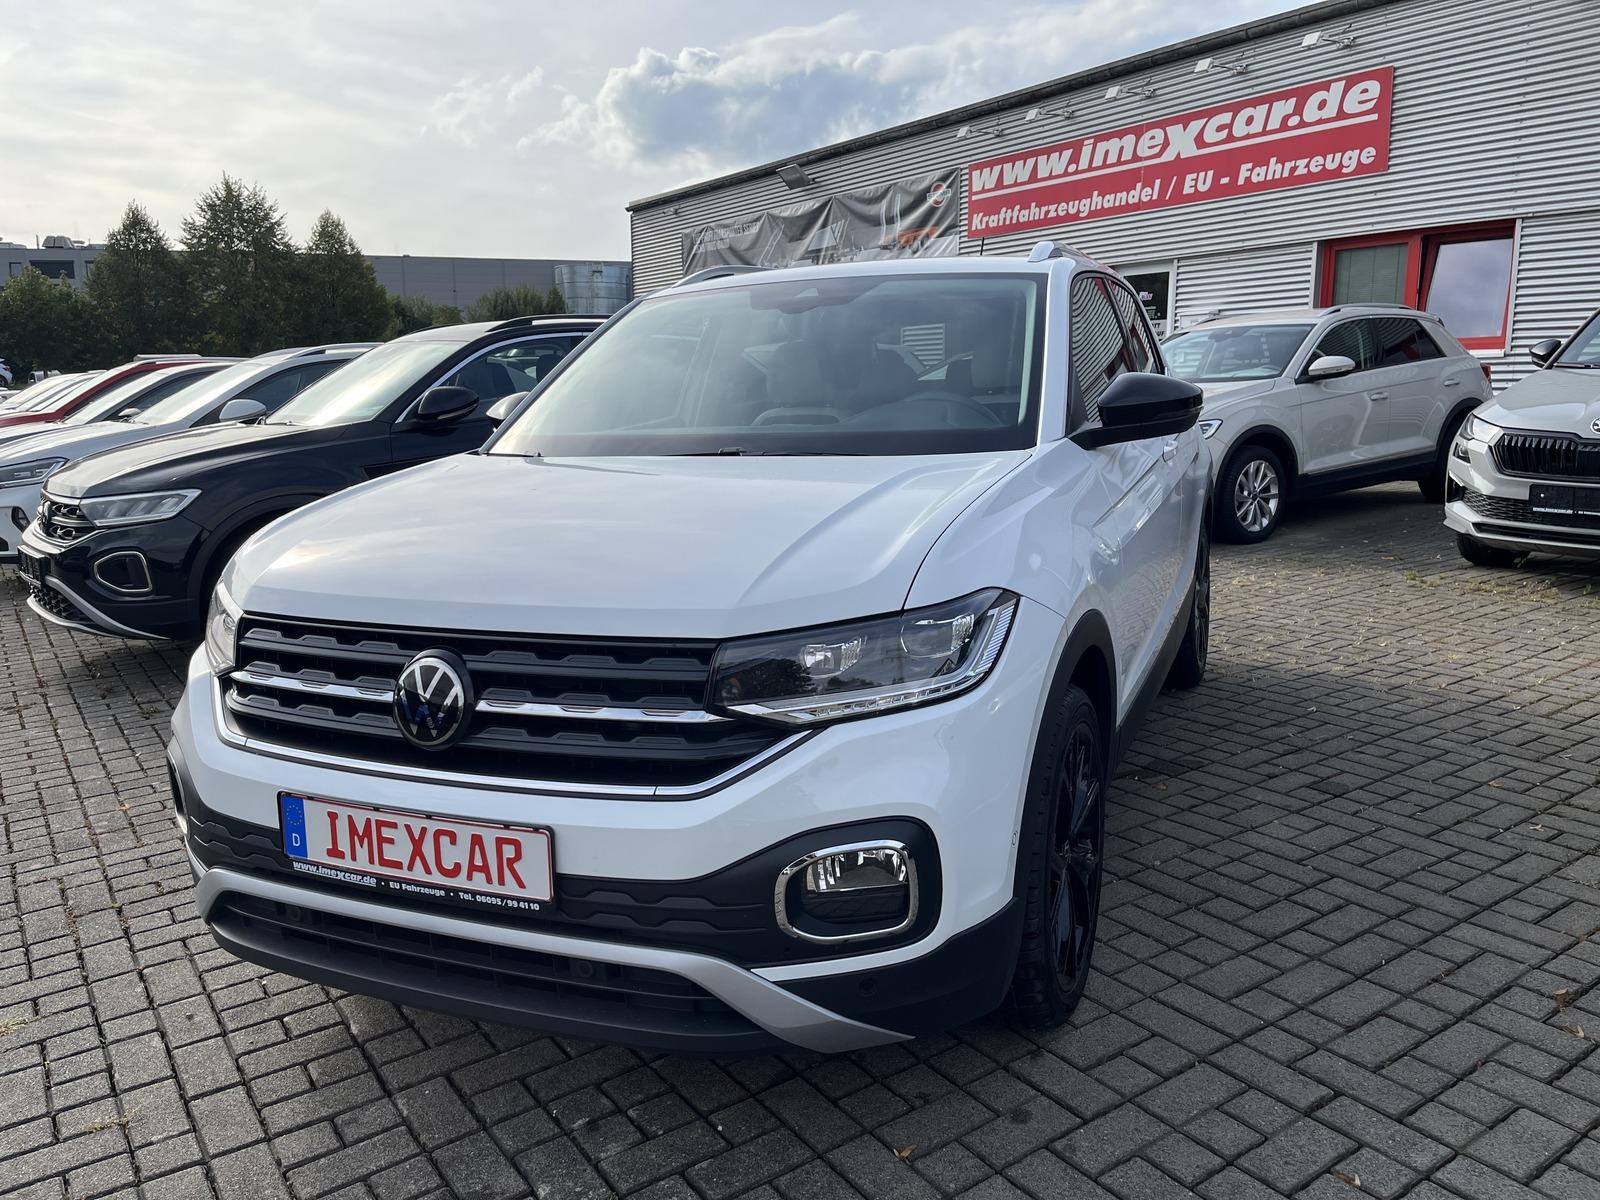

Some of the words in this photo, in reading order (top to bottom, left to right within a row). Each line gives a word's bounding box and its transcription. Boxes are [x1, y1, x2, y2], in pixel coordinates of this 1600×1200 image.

[971, 79, 1382, 193] www.imexcar.de
[971, 178, 1162, 231] Kraftfahrzeughandel
[1182, 169, 1214, 195] EU
[1236, 146, 1377, 186] Fahrzeuge
[292, 833, 301, 847] D
[326, 810, 526, 889] IMEXCAR
[292, 860, 377, 887] www.imexcar.de
[389, 881, 400, 890] EU
[401, 883, 446, 897] Fahrzeuge
[458, 892, 474, 901] Tel.
